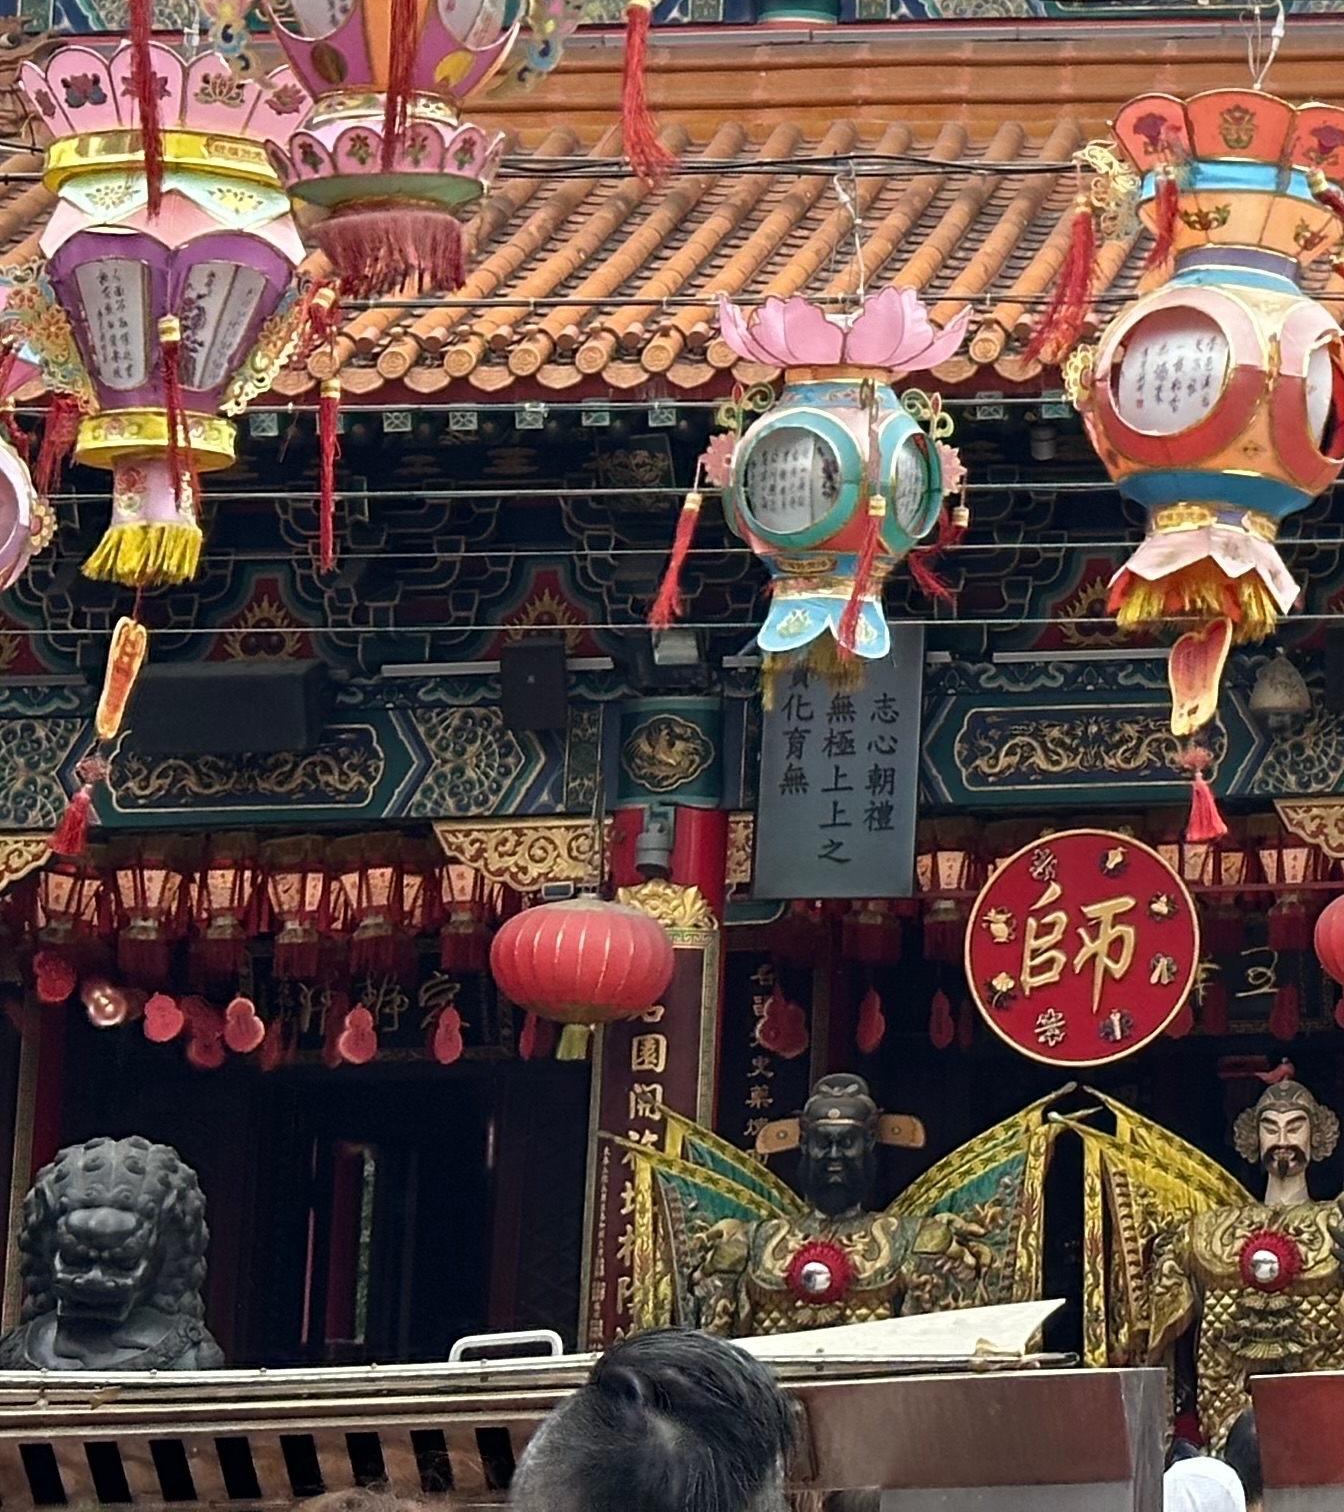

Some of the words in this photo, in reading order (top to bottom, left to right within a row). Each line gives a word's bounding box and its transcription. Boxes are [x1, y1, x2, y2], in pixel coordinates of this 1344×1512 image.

[862, 691, 901, 833] 志心朝禮
[1017, 882, 1137, 1015] 師
